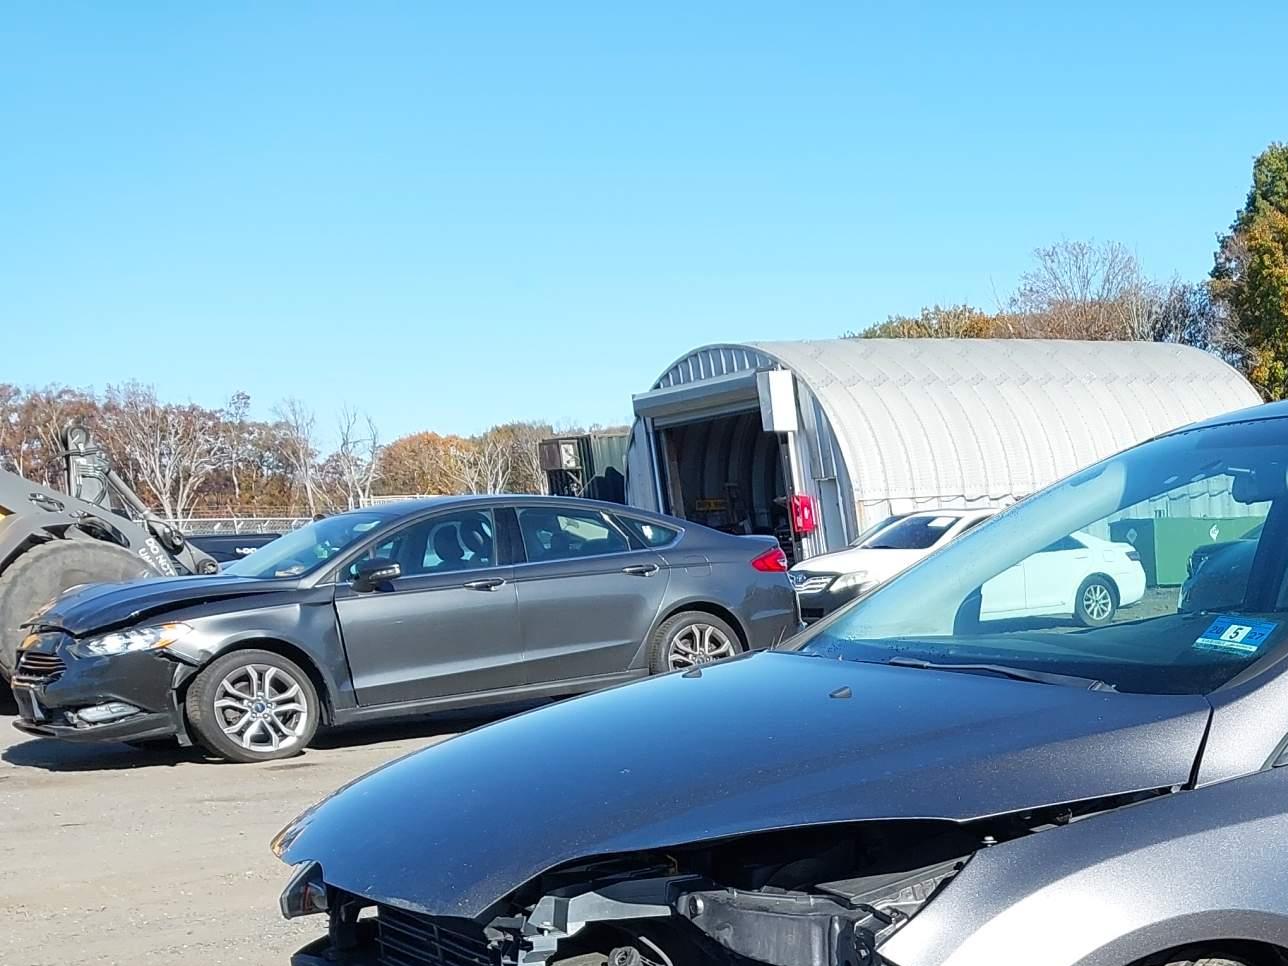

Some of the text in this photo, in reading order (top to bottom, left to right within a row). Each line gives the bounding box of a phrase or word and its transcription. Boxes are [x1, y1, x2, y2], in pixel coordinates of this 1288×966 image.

[145, 537, 176, 576] DO NOT
[1229, 627, 1244, 640] 5
